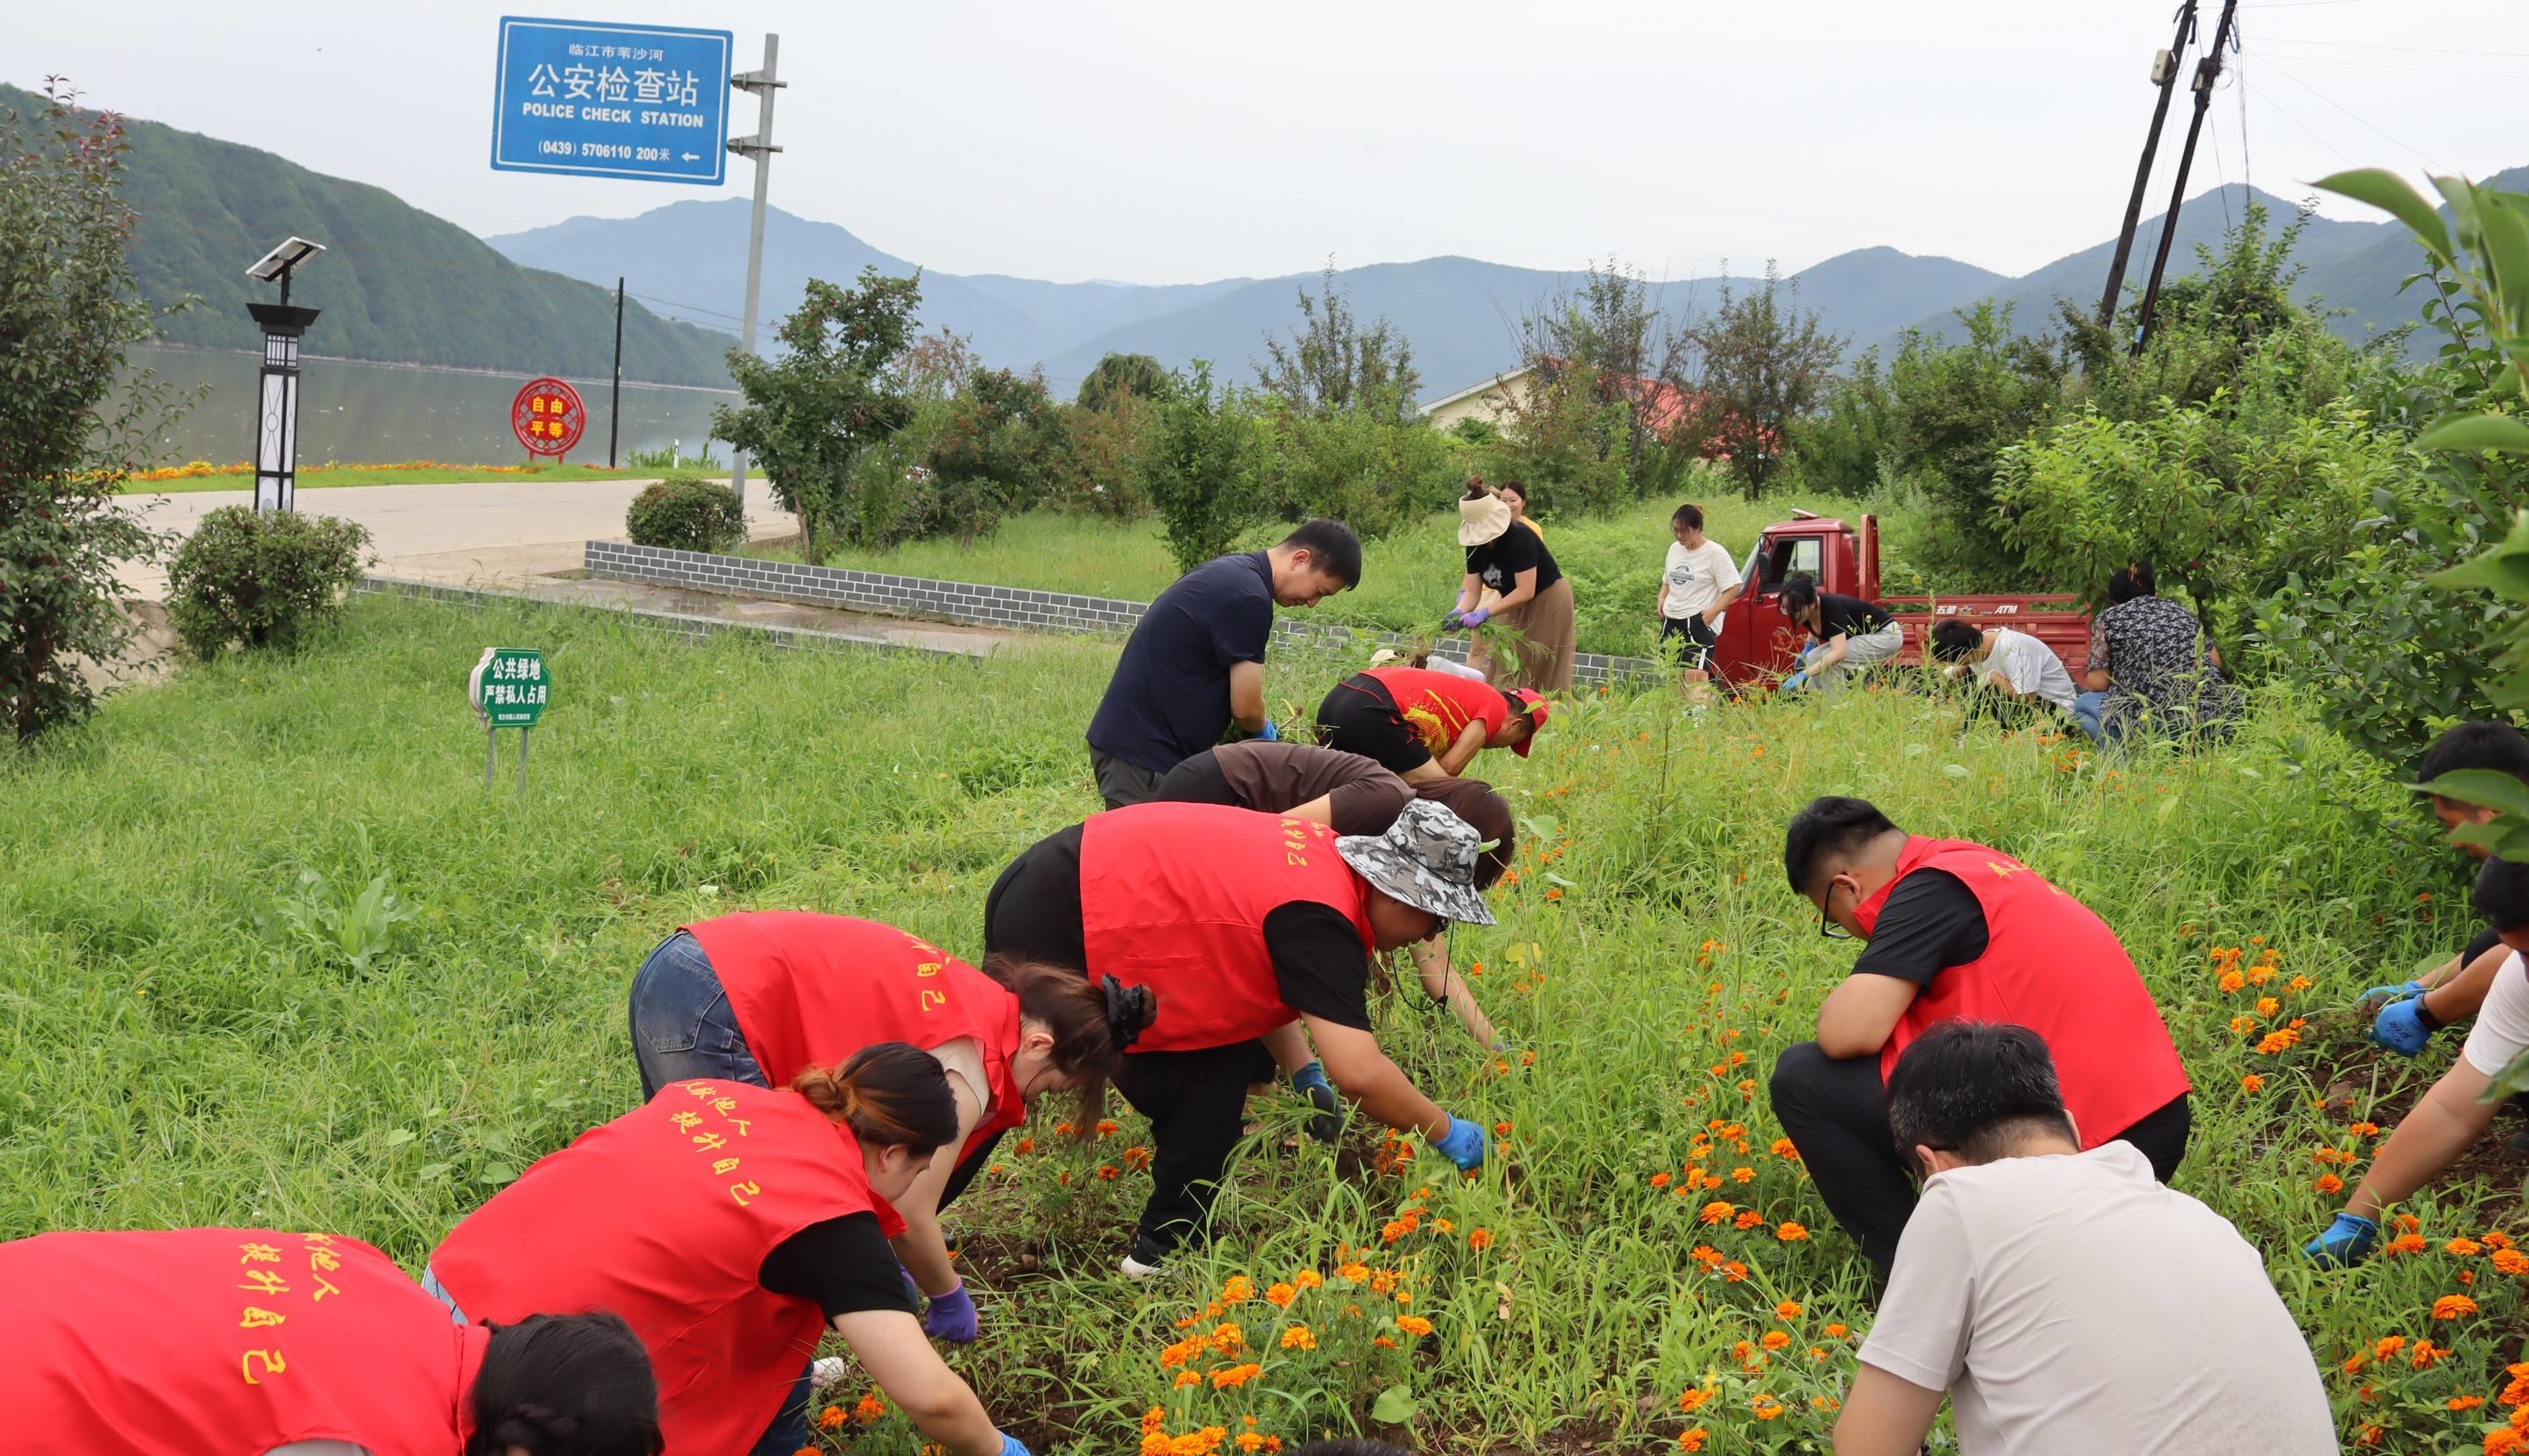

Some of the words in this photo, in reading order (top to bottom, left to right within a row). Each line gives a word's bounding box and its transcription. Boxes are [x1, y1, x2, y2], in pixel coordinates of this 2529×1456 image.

[569, 44, 664, 62] 临江市苇沙河
[528, 63, 700, 107] 公安检查站
[522, 103, 575, 119] POLICE
[582, 107, 631, 124] CHECK
[641, 111, 703, 128] STATION
[538, 140, 577, 156] (0439)
[582, 143, 631, 160] 5706110
[532, 396, 563, 414] 自由
[530, 420, 563, 437] 平等
[1994, 604, 2019, 614] ATM
[493, 657, 541, 680] 公共绿地
[484, 685, 547, 705] 严禁私人占用
[669, 1111, 761, 1207] 提升自己
[238, 1242, 291, 1386] 提升自己
